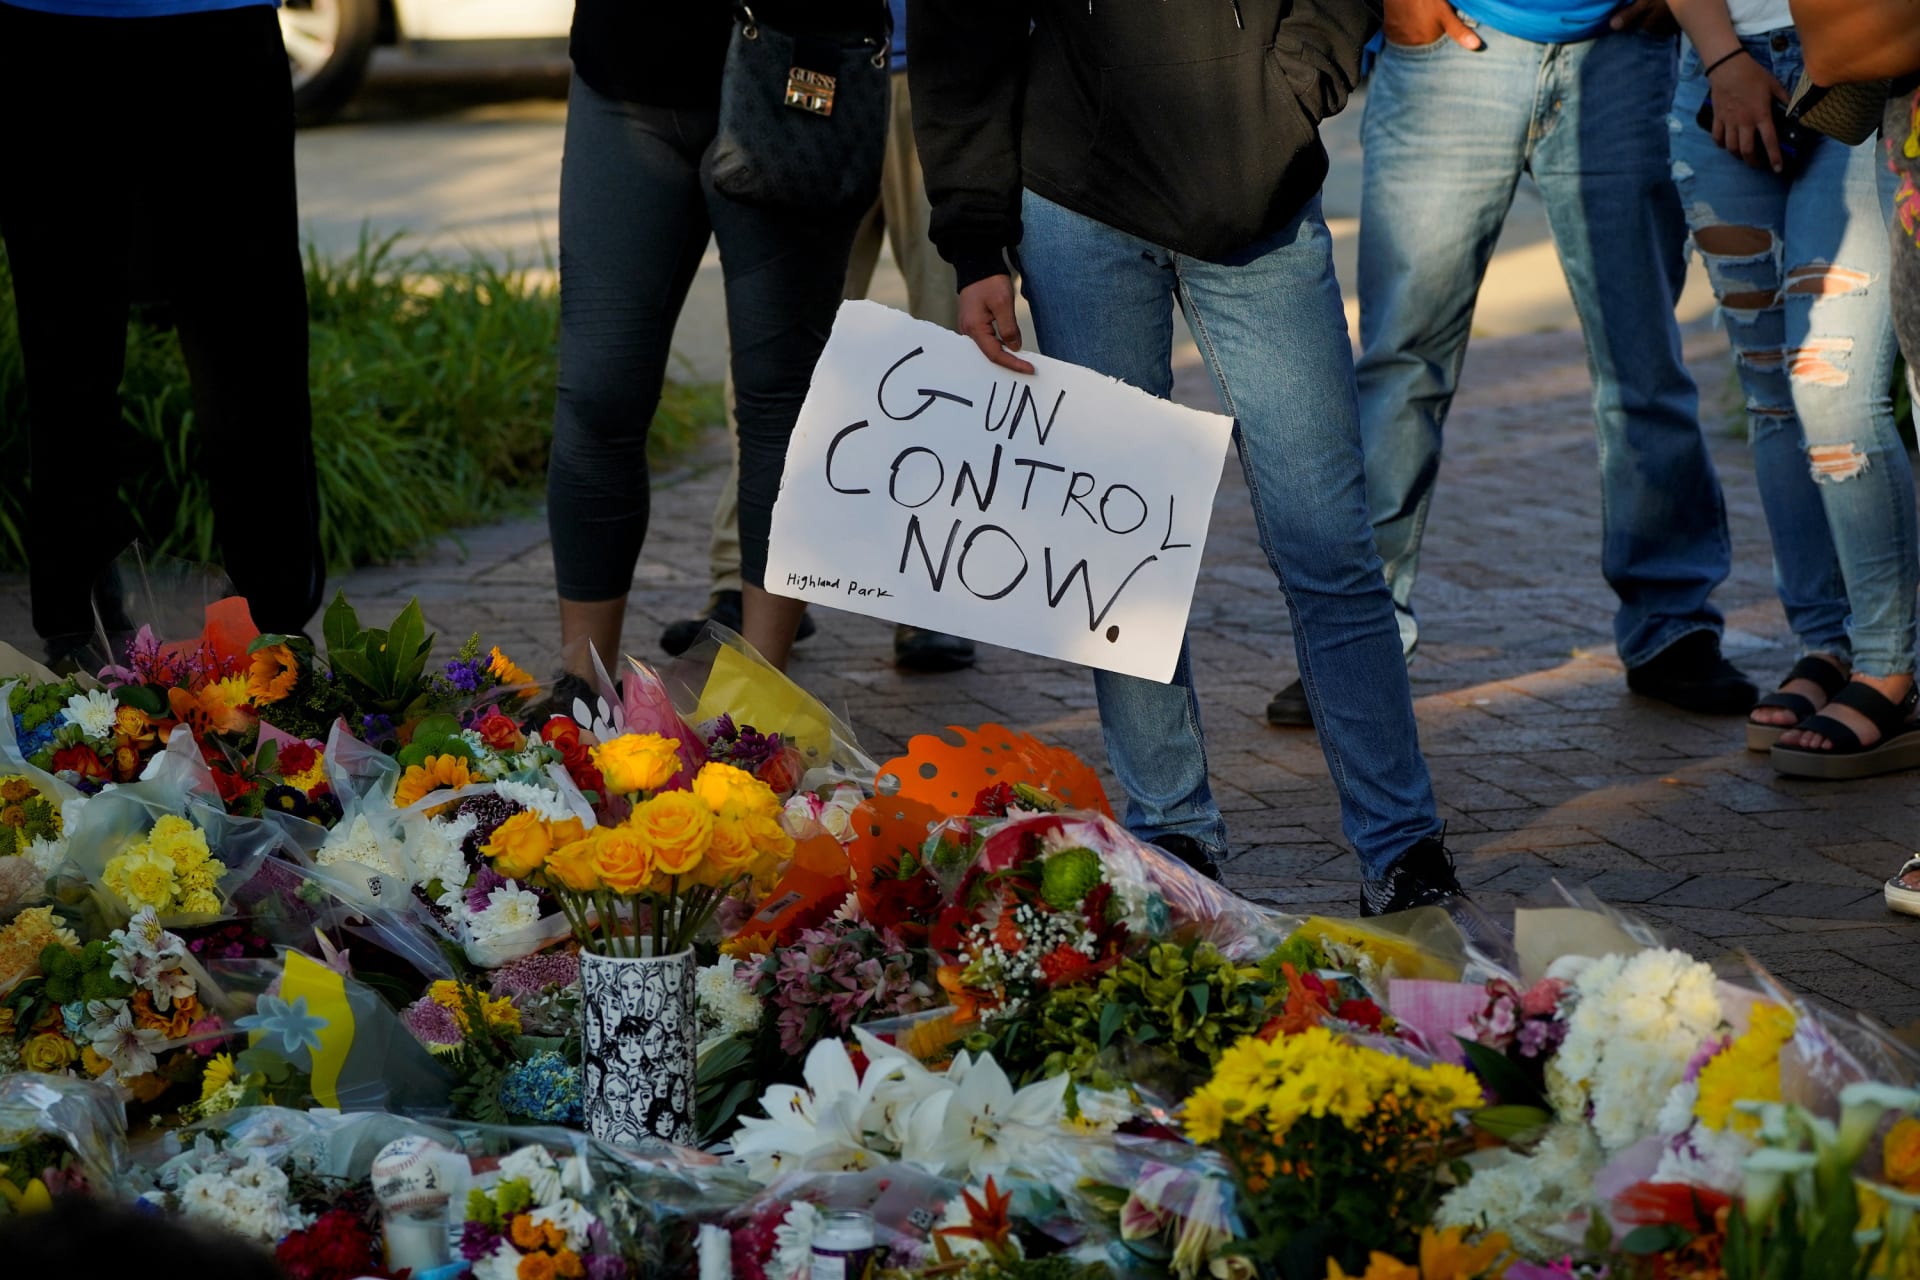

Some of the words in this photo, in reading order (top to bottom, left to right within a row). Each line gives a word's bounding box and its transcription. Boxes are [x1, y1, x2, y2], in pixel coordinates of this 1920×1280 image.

[790, 67, 836, 89] GUESS
[878, 347, 1066, 446] GUN
[825, 420, 1192, 551] CONTROL
[786, 573, 840, 590] Highland
[847, 581, 895, 598] Park
[899, 514, 1158, 643] NOW.
